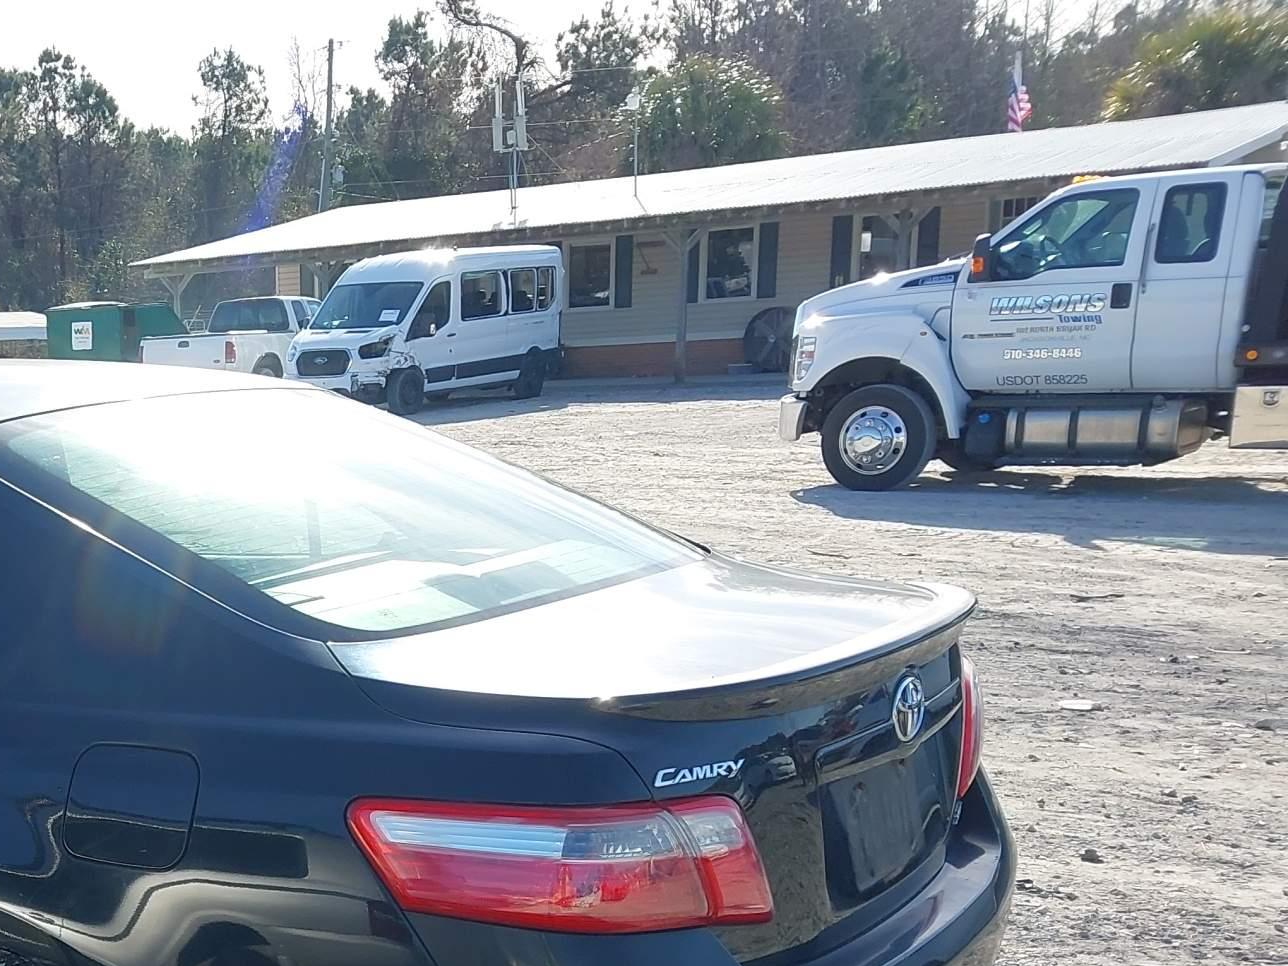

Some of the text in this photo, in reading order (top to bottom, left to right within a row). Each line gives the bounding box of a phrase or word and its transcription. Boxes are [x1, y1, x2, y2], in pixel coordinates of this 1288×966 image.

[989, 293, 1107, 315] WILSONS
[1057, 314, 1103, 324] Towing
[996, 374, 1088, 386] USDOT 858225
[654, 758, 745, 788] CAMRY
